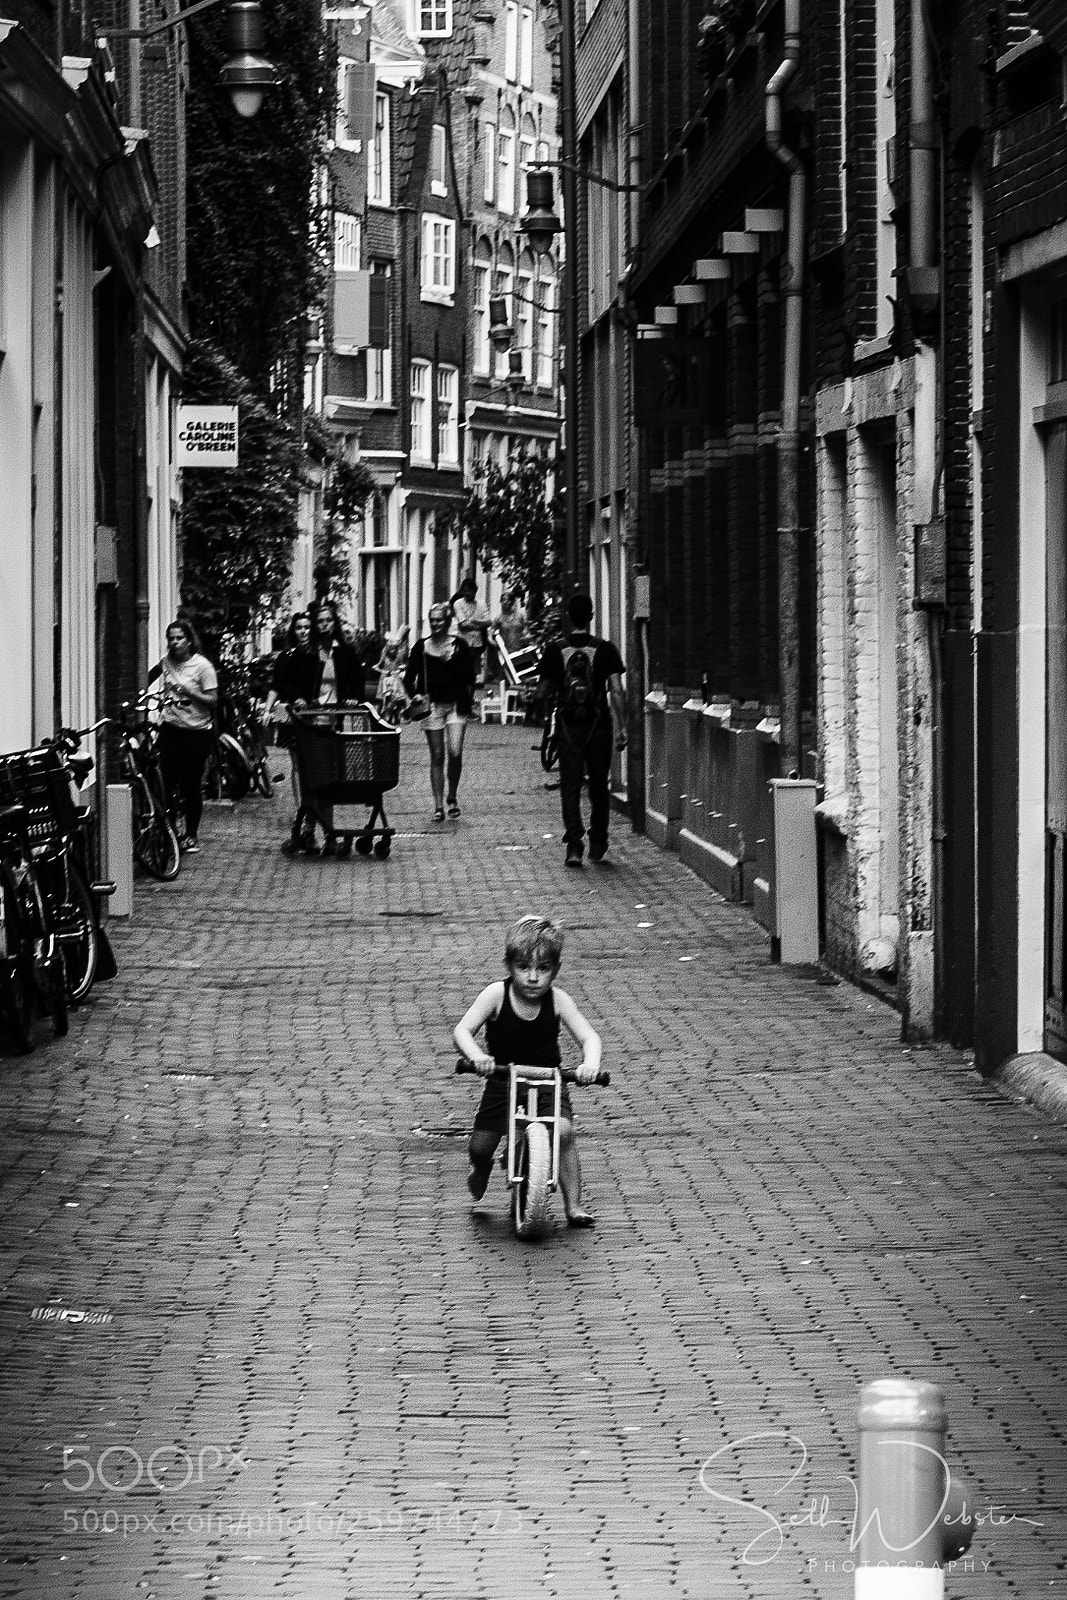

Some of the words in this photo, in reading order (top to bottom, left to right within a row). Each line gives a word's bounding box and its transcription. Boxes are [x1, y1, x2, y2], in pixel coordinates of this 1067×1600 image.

[187, 422, 236, 431] GALERIE
[179, 432, 236, 441] CAROLINE
[186, 442, 236, 451] O'BREEN
